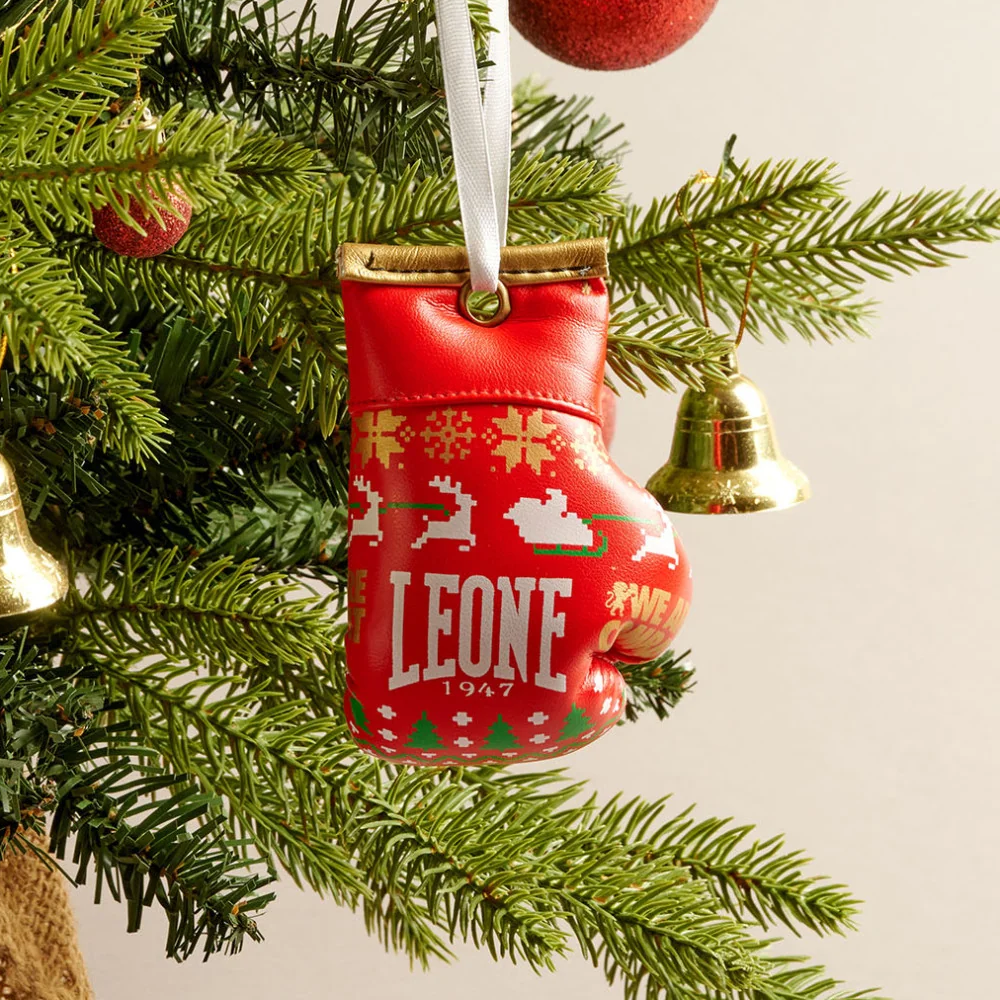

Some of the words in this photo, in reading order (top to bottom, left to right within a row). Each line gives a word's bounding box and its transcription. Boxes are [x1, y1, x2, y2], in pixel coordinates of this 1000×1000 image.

[629, 582, 671, 625] WE
[388, 570, 573, 693] LEONE
[443, 680, 515, 698] 1947
